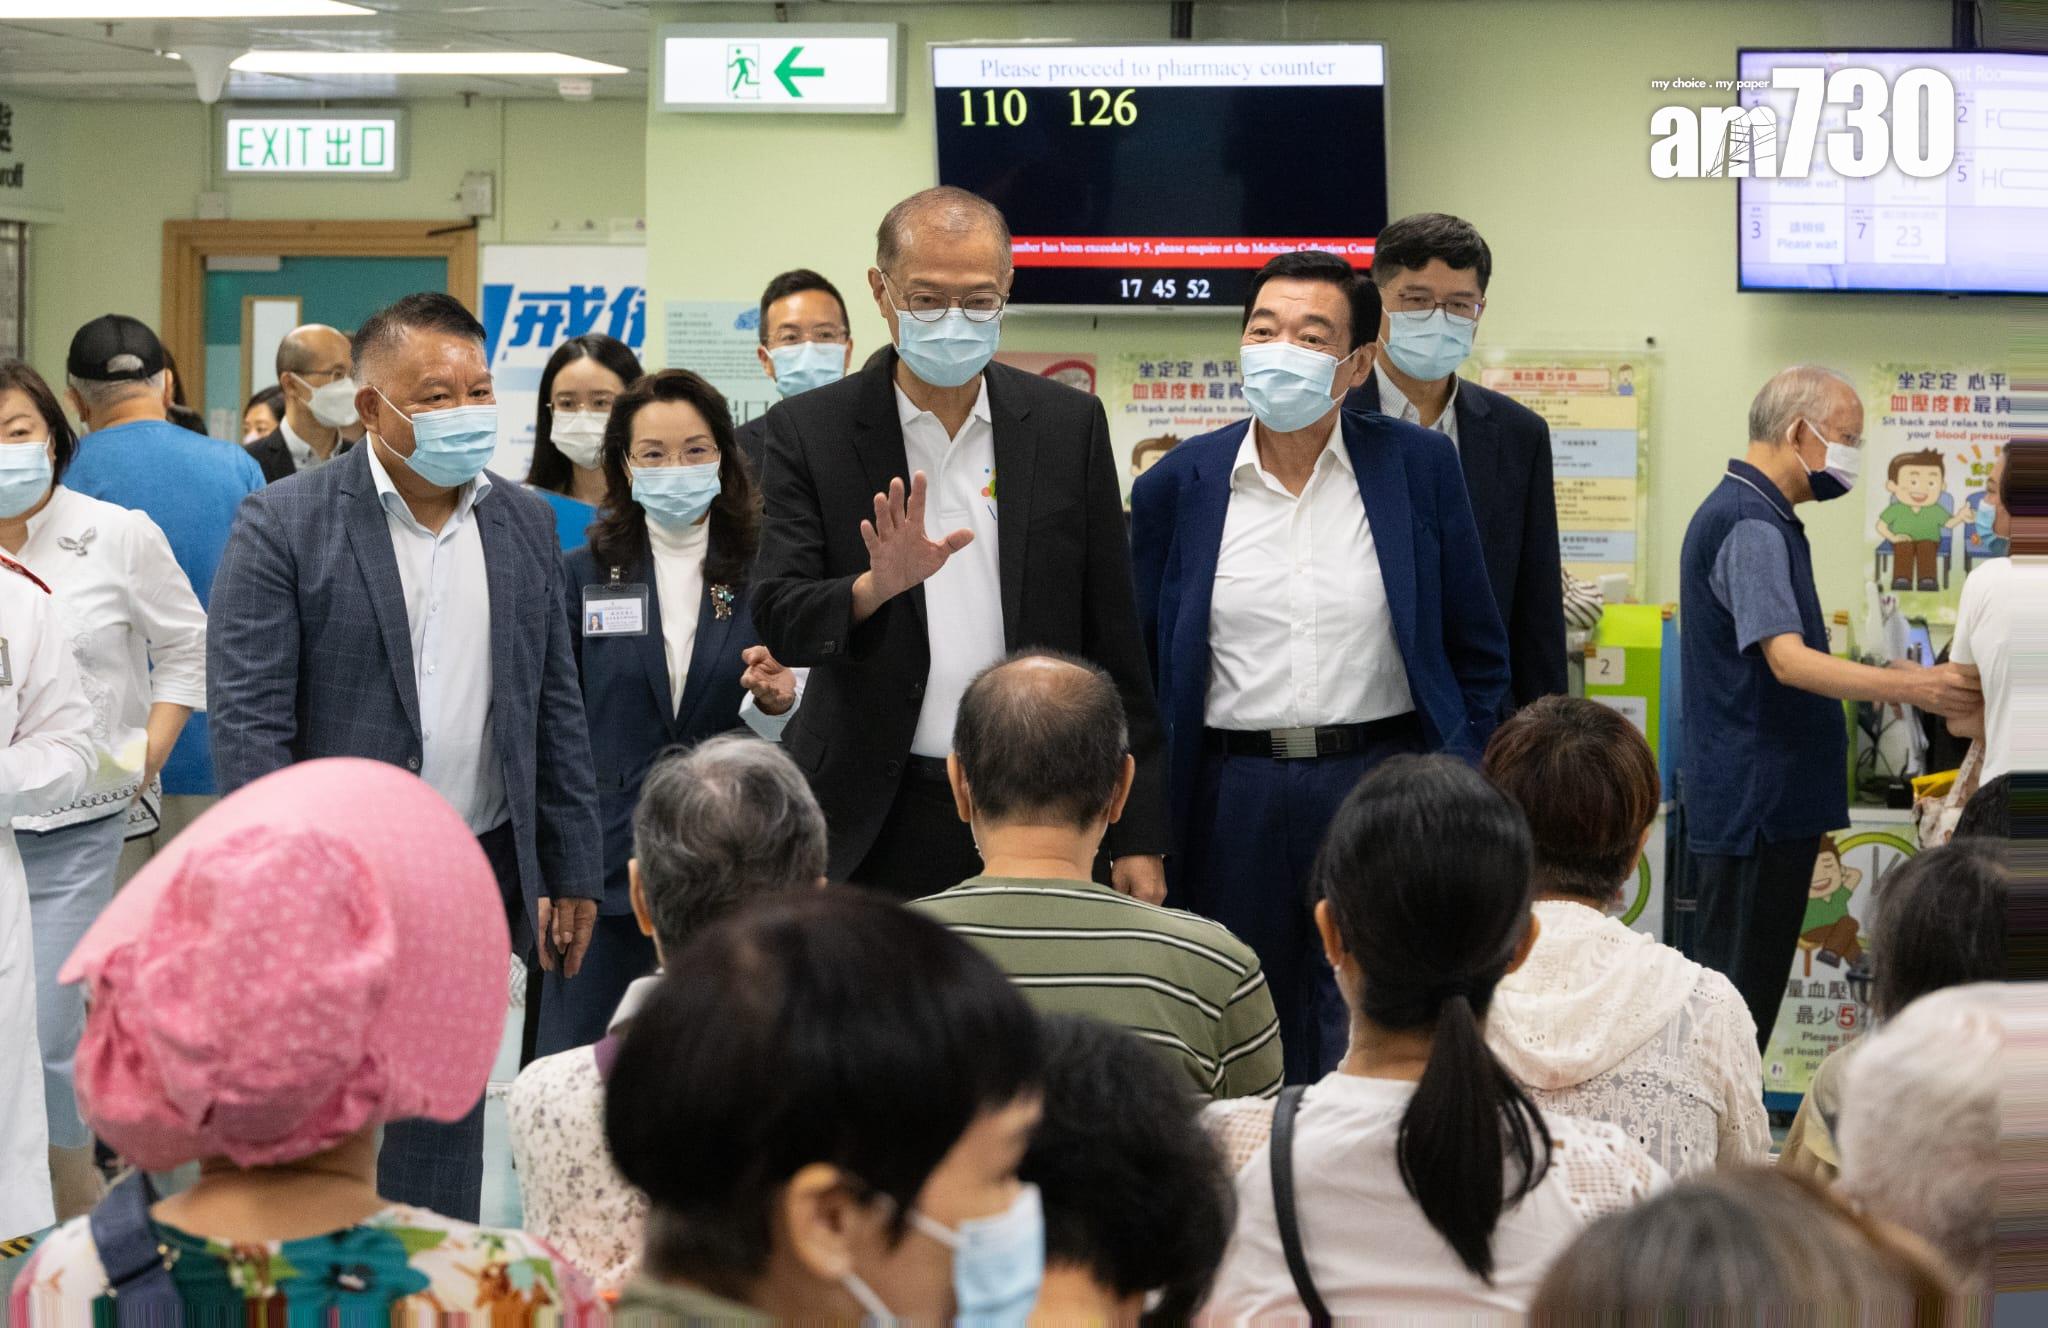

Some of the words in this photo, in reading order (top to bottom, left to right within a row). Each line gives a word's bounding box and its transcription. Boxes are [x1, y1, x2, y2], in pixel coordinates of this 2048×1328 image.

[981, 58, 1041, 77] Please
[1049, 58, 1125, 81] proceed
[1132, 61, 1150, 77] to
[1158, 58, 1252, 80] pharmacy
[1261, 60, 1336, 77] counter
[960, 88, 1028, 127] 110
[1069, 88, 1138, 127] 126
[1957, 106, 1968, 123] 2
[239, 127, 312, 166] EXIT
[326, 127, 385, 166] 出口
[1957, 165, 1967, 182] 5
[1751, 220, 1761, 239] 3
[1856, 222, 1866, 239] 7
[1895, 225, 1922, 247] 23
[1129, 242, 1140, 255] by
[1223, 242, 1233, 253] at
[1234, 242, 1250, 253] the
[1777, 238, 1811, 250] Please
[1816, 239, 1838, 250] wait
[1120, 278, 1143, 298] 17
[1152, 278, 1177, 299] 45
[1186, 278, 1211, 299] 52
[1898, 371, 1958, 391] 坐定定
[1882, 416, 1896, 427] Sit
[1899, 416, 1925, 427] back
[1928, 417, 1949, 428] and
[1951, 417, 1978, 429] relax
[1982, 418, 1994, 429] to
[1907, 431, 1932, 441] your
[1935, 431, 1967, 441] blood
[1600, 658, 1611, 675] 2
